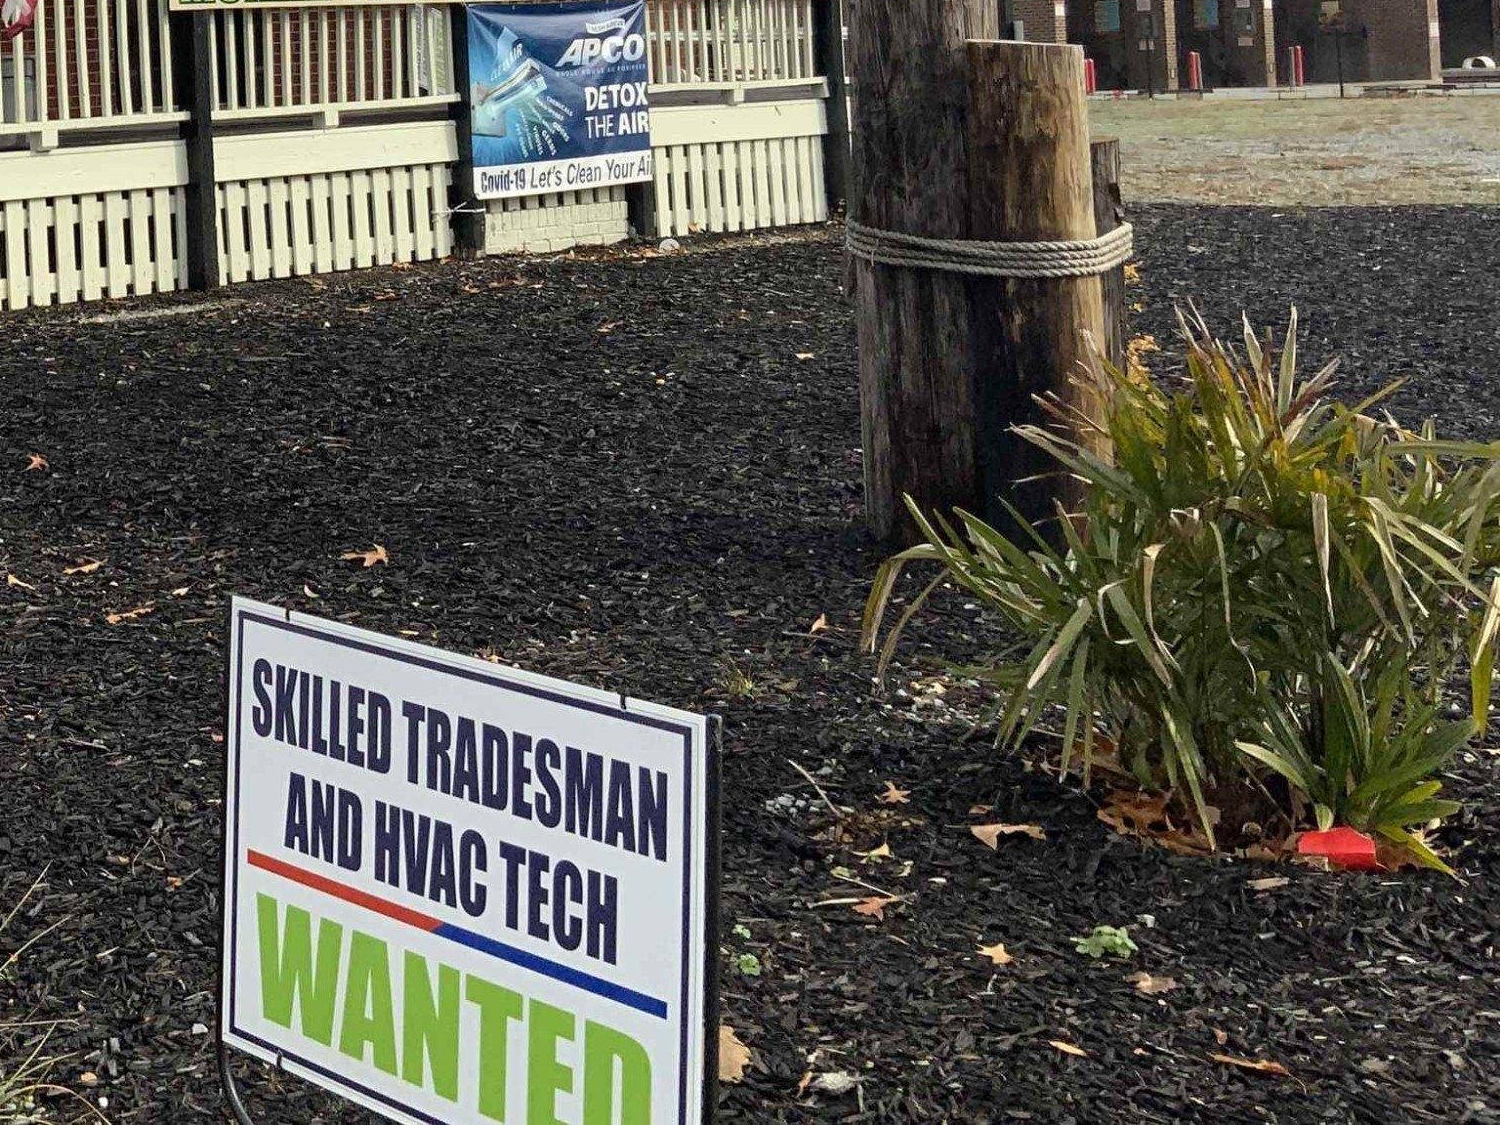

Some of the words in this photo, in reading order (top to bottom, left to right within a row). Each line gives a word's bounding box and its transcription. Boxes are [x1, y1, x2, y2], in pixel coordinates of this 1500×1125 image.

[555, 34, 644, 67] APCO
[584, 81, 649, 112] DETOX
[585, 114, 614, 139] THE
[618, 111, 649, 135] AIR
[481, 168, 526, 193] Covid-19
[531, 168, 562, 189] Let's
[567, 163, 601, 184] Clean
[606, 159, 635, 180] Your
[252, 658, 391, 775] SKILLED
[402, 700, 668, 862] TRADESMAN
[285, 772, 362, 872] AND
[374, 800, 488, 917] HVAC
[500, 840, 618, 966] TECH
[256, 891, 652, 1125] WANTED
